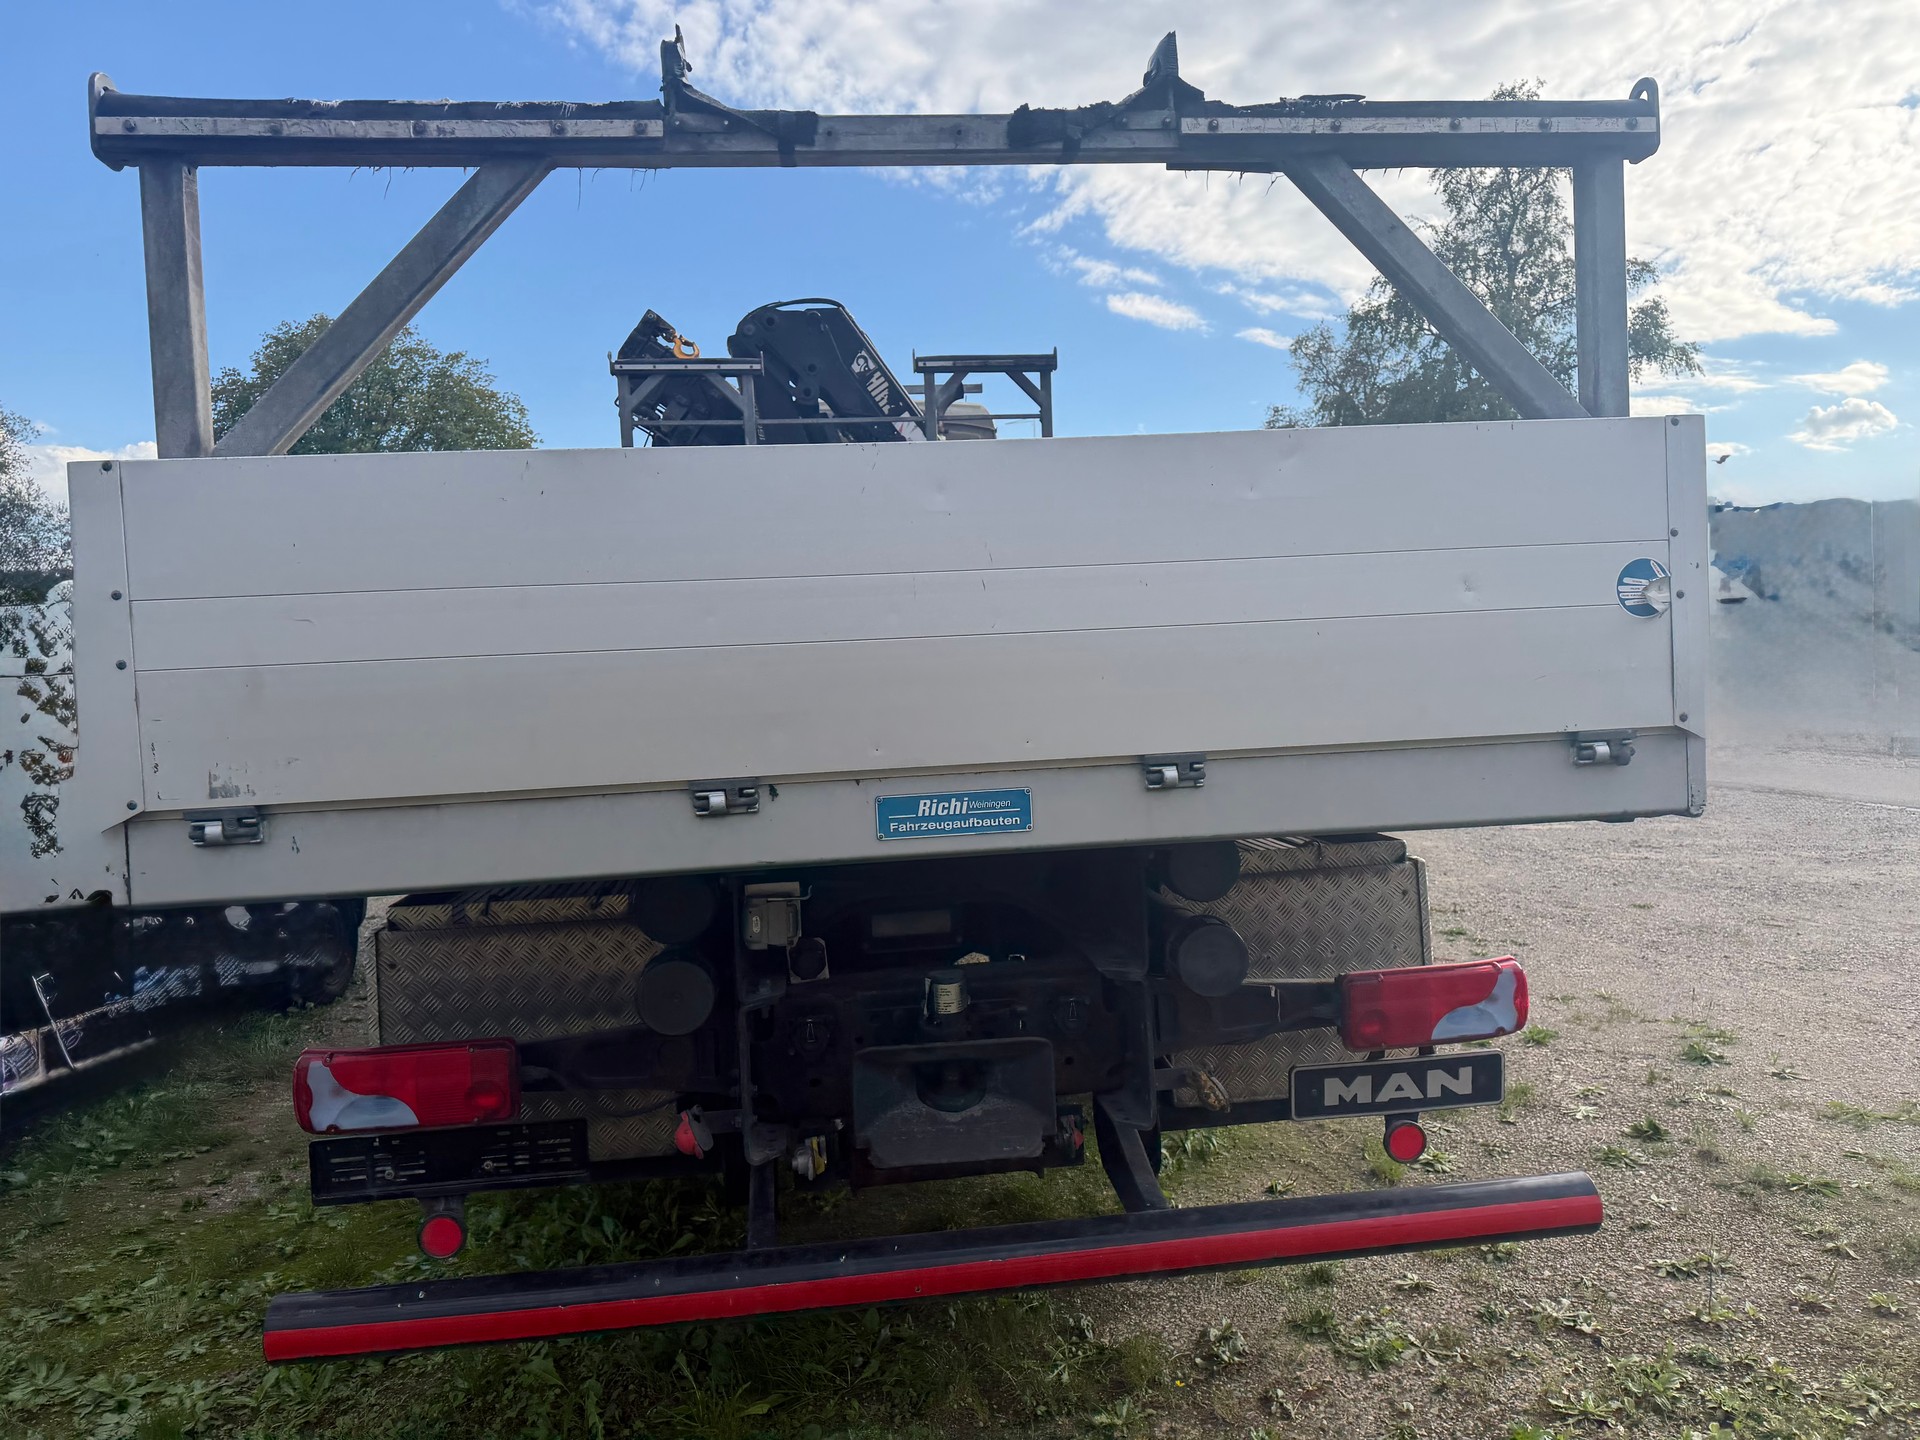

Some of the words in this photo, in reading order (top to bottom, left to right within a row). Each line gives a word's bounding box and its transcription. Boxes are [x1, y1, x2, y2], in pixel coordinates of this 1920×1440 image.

[918, 797, 968, 817] Richi
[969, 800, 1011, 809] Weiningen
[890, 817, 1020, 832] Fahrzeugaufbauten
[1324, 1066, 1472, 1106] MAN
